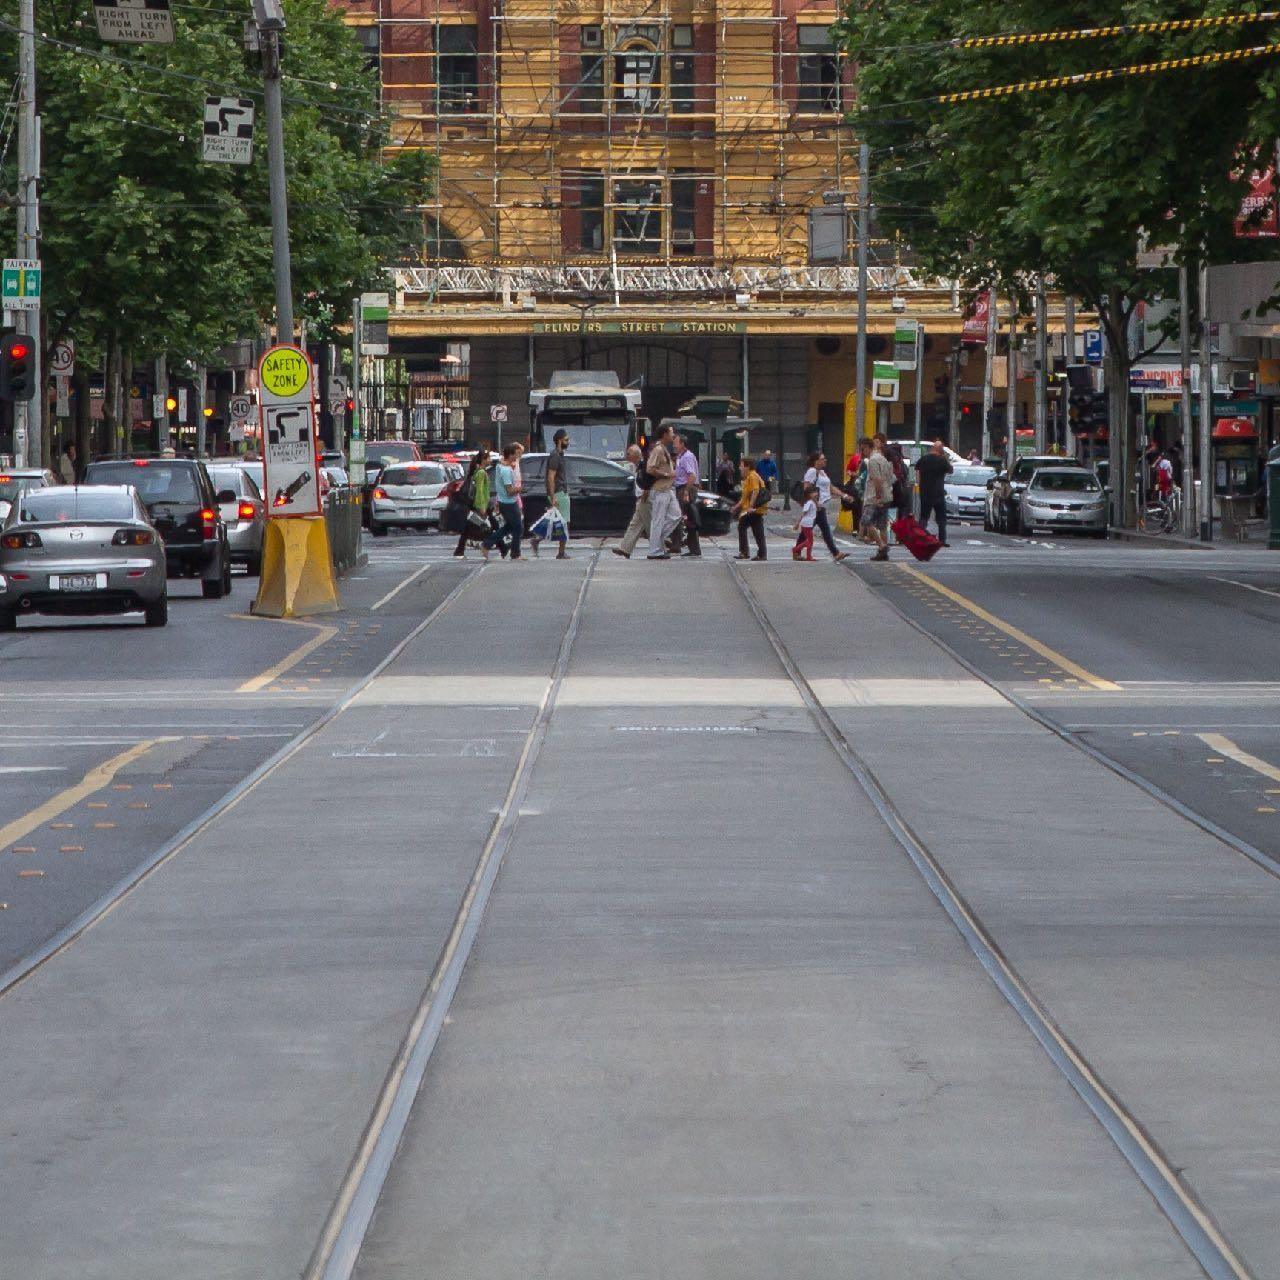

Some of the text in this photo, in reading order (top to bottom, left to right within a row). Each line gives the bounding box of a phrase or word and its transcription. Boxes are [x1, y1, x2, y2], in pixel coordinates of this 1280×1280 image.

[99, 10, 167, 20] RIGHT TURN
[102, 20, 132, 28] FROM
[118, 29, 155, 39] AHEAD
[620, 322, 665, 333] STREET
[683, 321, 737, 333] STATION
[1086, 331, 1100, 348] P
[266, 358, 302, 372] SAFETY
[273, 374, 298, 388] ZONE
